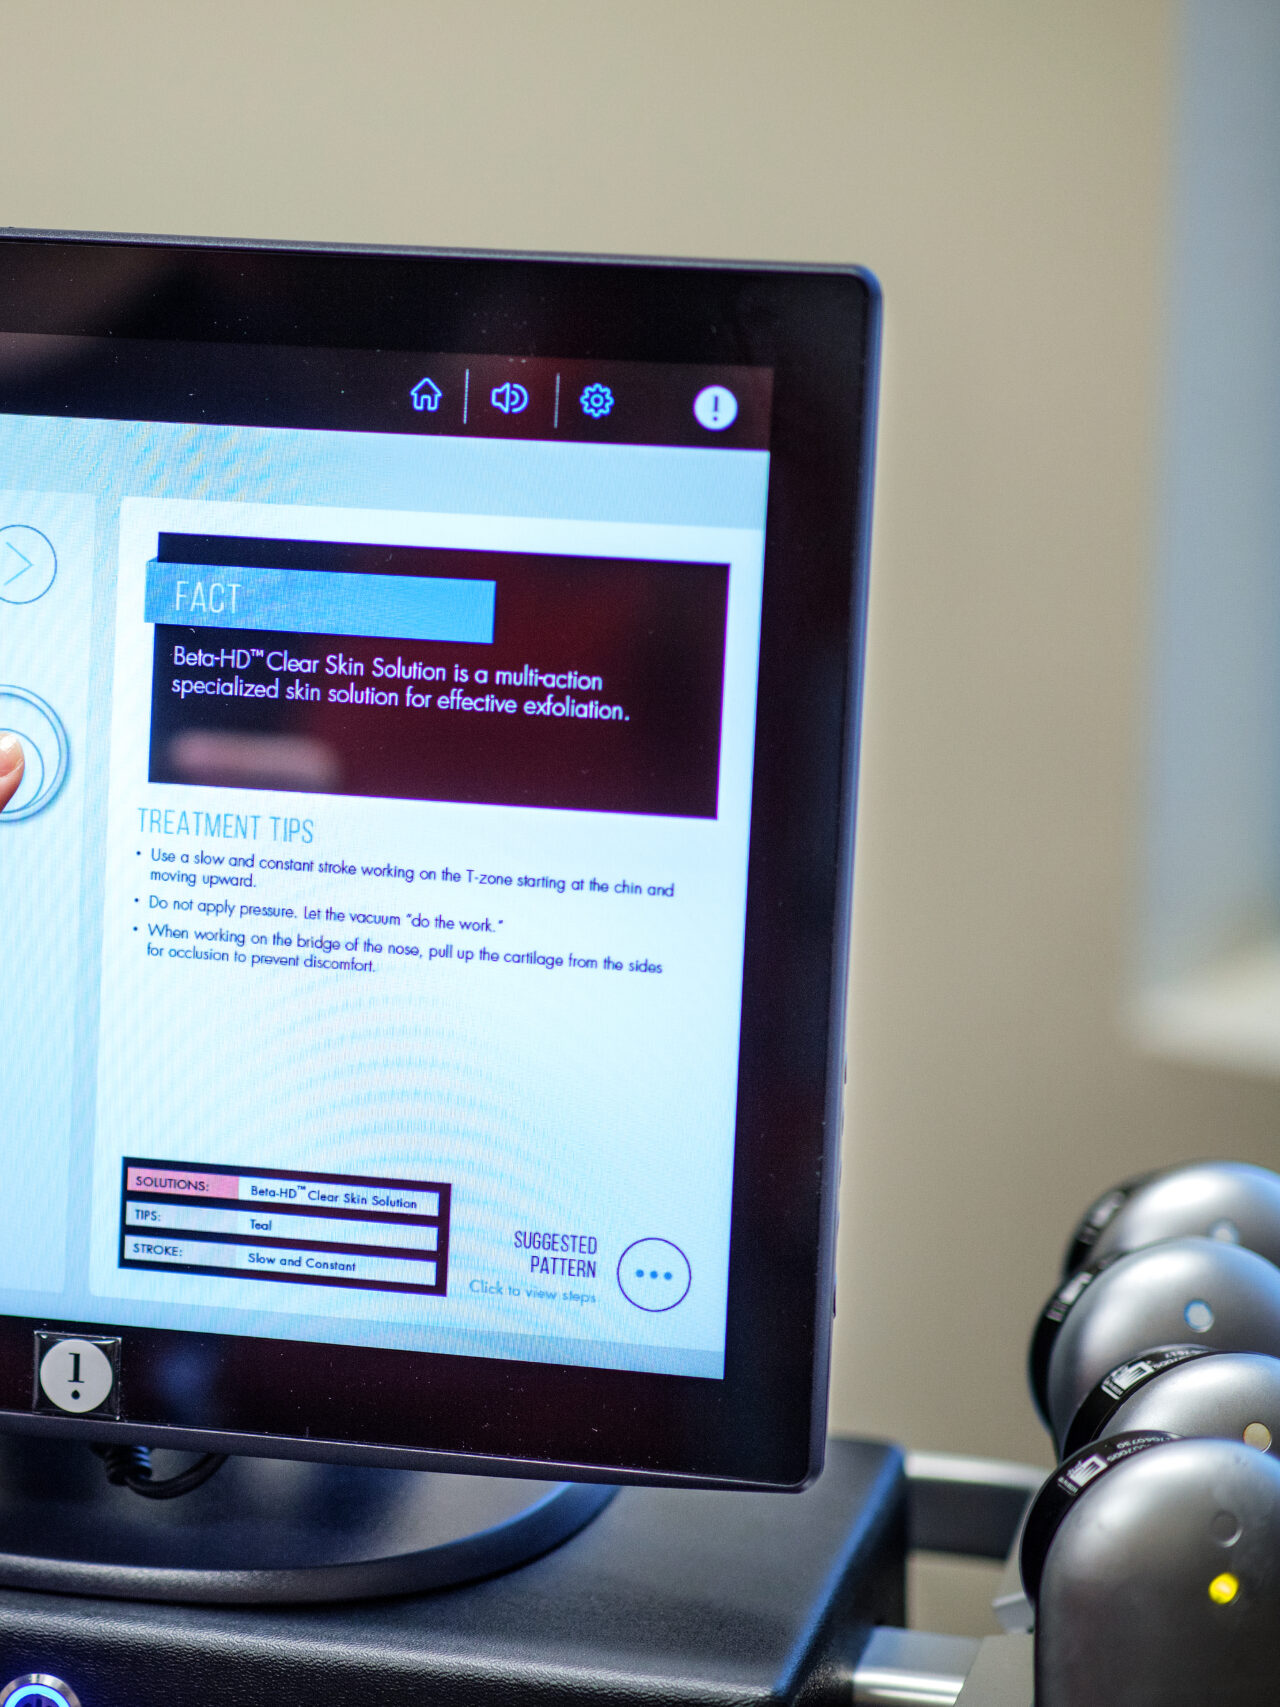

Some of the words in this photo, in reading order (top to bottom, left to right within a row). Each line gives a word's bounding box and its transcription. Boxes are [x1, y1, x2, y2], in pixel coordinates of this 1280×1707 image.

[175, 580, 242, 614] FACT
[266, 649, 320, 674] Clear
[325, 652, 365, 677] Skin
[371, 655, 447, 682] Solution
[453, 663, 469, 683] is
[474, 669, 489, 684] a
[495, 663, 603, 691] multi-action
[171, 675, 280, 700] specialized
[285, 678, 321, 701] skin
[327, 681, 399, 706] solution
[405, 685, 432, 708] for
[437, 687, 518, 714] effective
[523, 693, 631, 722] exfoliation.
[138, 807, 261, 841] TREATMENT
[269, 816, 315, 844] TIPS
[150, 869, 197, 887] moving
[202, 873, 257, 889] upward.
[151, 848, 176, 863] Use
[180, 852, 190, 864] a
[194, 850, 225, 867] slow
[228, 853, 255, 868] and
[259, 857, 314, 873] constant
[318, 860, 357, 876] stroke
[361, 863, 415, 883] working
[419, 868, 437, 881] on
[441, 867, 462, 882] the
[466, 869, 513, 886] T-zone
[516, 874, 566, 894] starting
[571, 877, 584, 891] at
[589, 877, 609, 893] the
[614, 879, 643, 895] chin
[647, 883, 675, 898] and
[148, 894, 169, 910] Do
[173, 898, 193, 911] not
[197, 899, 235, 918] apply
[239, 903, 297, 922] pressure.
[303, 905, 322, 920] Let
[325, 907, 346, 922] the
[349, 911, 401, 926] vacuum
[434, 914, 455, 930] the
[146, 942, 164, 957] for
[168, 945, 229, 962] occlusion
[234, 949, 247, 964] to
[251, 952, 300, 968] prevent
[303, 954, 376, 973] discomfort.
[147, 923, 189, 939] When
[194, 926, 245, 947] working
[250, 931, 268, 945] on
[272, 931, 293, 947] the
[296, 933, 341, 954] bridge
[344, 937, 360, 952] of
[363, 938, 383, 954] the
[387, 943, 423, 959] nose,
[428, 944, 453, 961] pull
[457, 948, 474, 963] up
[479, 947, 500, 962] the
[503, 951, 563, 970] cartilage
[568, 953, 598, 969] from
[603, 956, 623, 971] the
[628, 958, 663, 974] sides
[135, 1175, 210, 1193] SOLUTIONS:
[307, 1189, 339, 1203] Clear
[343, 1192, 368, 1206] Skin
[371, 1194, 418, 1210] Solution
[135, 1209, 162, 1223] TIPS:
[250, 1218, 272, 1232] Teal
[133, 1242, 183, 1258] STROKE:
[248, 1252, 276, 1265] Slow
[279, 1254, 302, 1268] and
[305, 1257, 356, 1272] Constant
[513, 1230, 598, 1255] SUGGESTED
[530, 1255, 597, 1278] PATTERN
[469, 1279, 503, 1296] Click
[508, 1285, 521, 1297] to
[526, 1287, 557, 1300] view
[562, 1290, 596, 1306] steps
